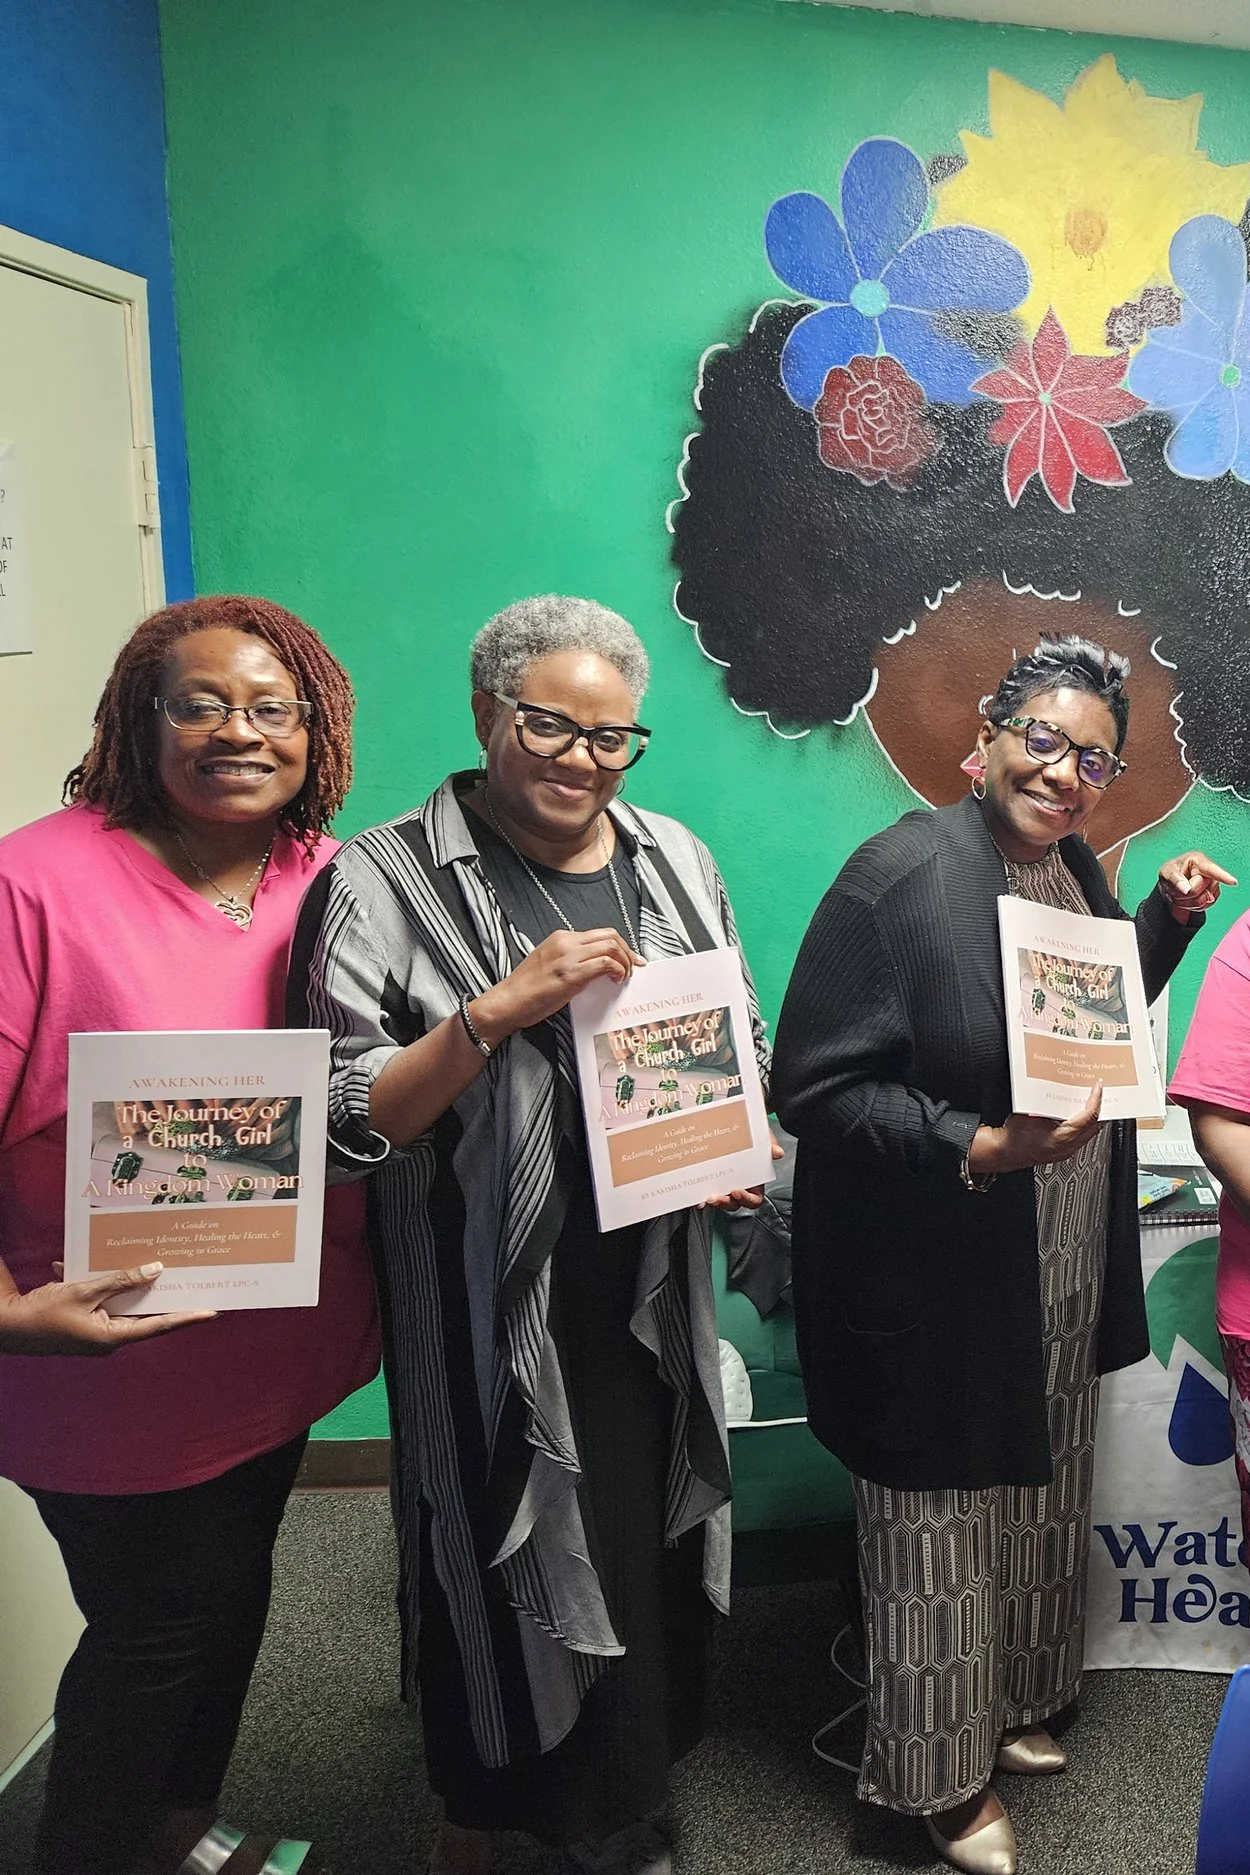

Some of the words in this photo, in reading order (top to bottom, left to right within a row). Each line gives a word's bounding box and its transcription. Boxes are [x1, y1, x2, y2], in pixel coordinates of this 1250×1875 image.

[1034, 935, 1080, 952] AWAKENING
[1083, 946, 1100, 955] HER
[1032, 951, 1052, 972] The
[1053, 959, 1096, 982] Journey
[1100, 967, 1114, 981] of
[1035, 976, 1040, 986] a
[1046, 976, 1080, 997] Church
[1088, 984, 1108, 1000] Girl
[615, 996, 679, 1019] AWAKENING
[682, 993, 704, 1005] HER
[1064, 998, 1075, 1009] to
[614, 1032, 639, 1050] The
[643, 1021, 698, 1046] Journey
[704, 1010, 723, 1029] of
[1031, 1008, 1078, 1031] Kingdom
[1080, 1018, 1132, 1033] Woman
[618, 1061, 626, 1073] a
[635, 1041, 684, 1067] Church
[691, 1033, 716, 1055] Girl
[129, 1077, 229, 1088] AWAKENING
[235, 1076, 265, 1086] HER
[661, 1069, 677, 1082] to
[599, 1106, 611, 1121] A
[615, 1088, 683, 1118] Kingdom
[685, 1074, 744, 1097] Woman
[118, 1105, 161, 1123] The
[163, 1105, 255, 1124] Journey
[259, 1101, 287, 1120] of
[123, 1135, 132, 1148] a
[149, 1124, 222, 1148] Church
[236, 1125, 272, 1145] Girl
[184, 1153, 207, 1167] to
[82, 1181, 100, 1197] A
[107, 1174, 210, 1199] Kingdom
[216, 1173, 303, 1190] Woman
[171, 1222, 179, 1230] A
[182, 1221, 207, 1229] Guide
[107, 1237, 153, 1246] Reclaiming
[194, 1233, 226, 1243] Healing
[157, 1248, 194, 1257] Growing
[207, 1246, 231, 1254] Grace
[186, 1281, 230, 1289] TOLBERT
